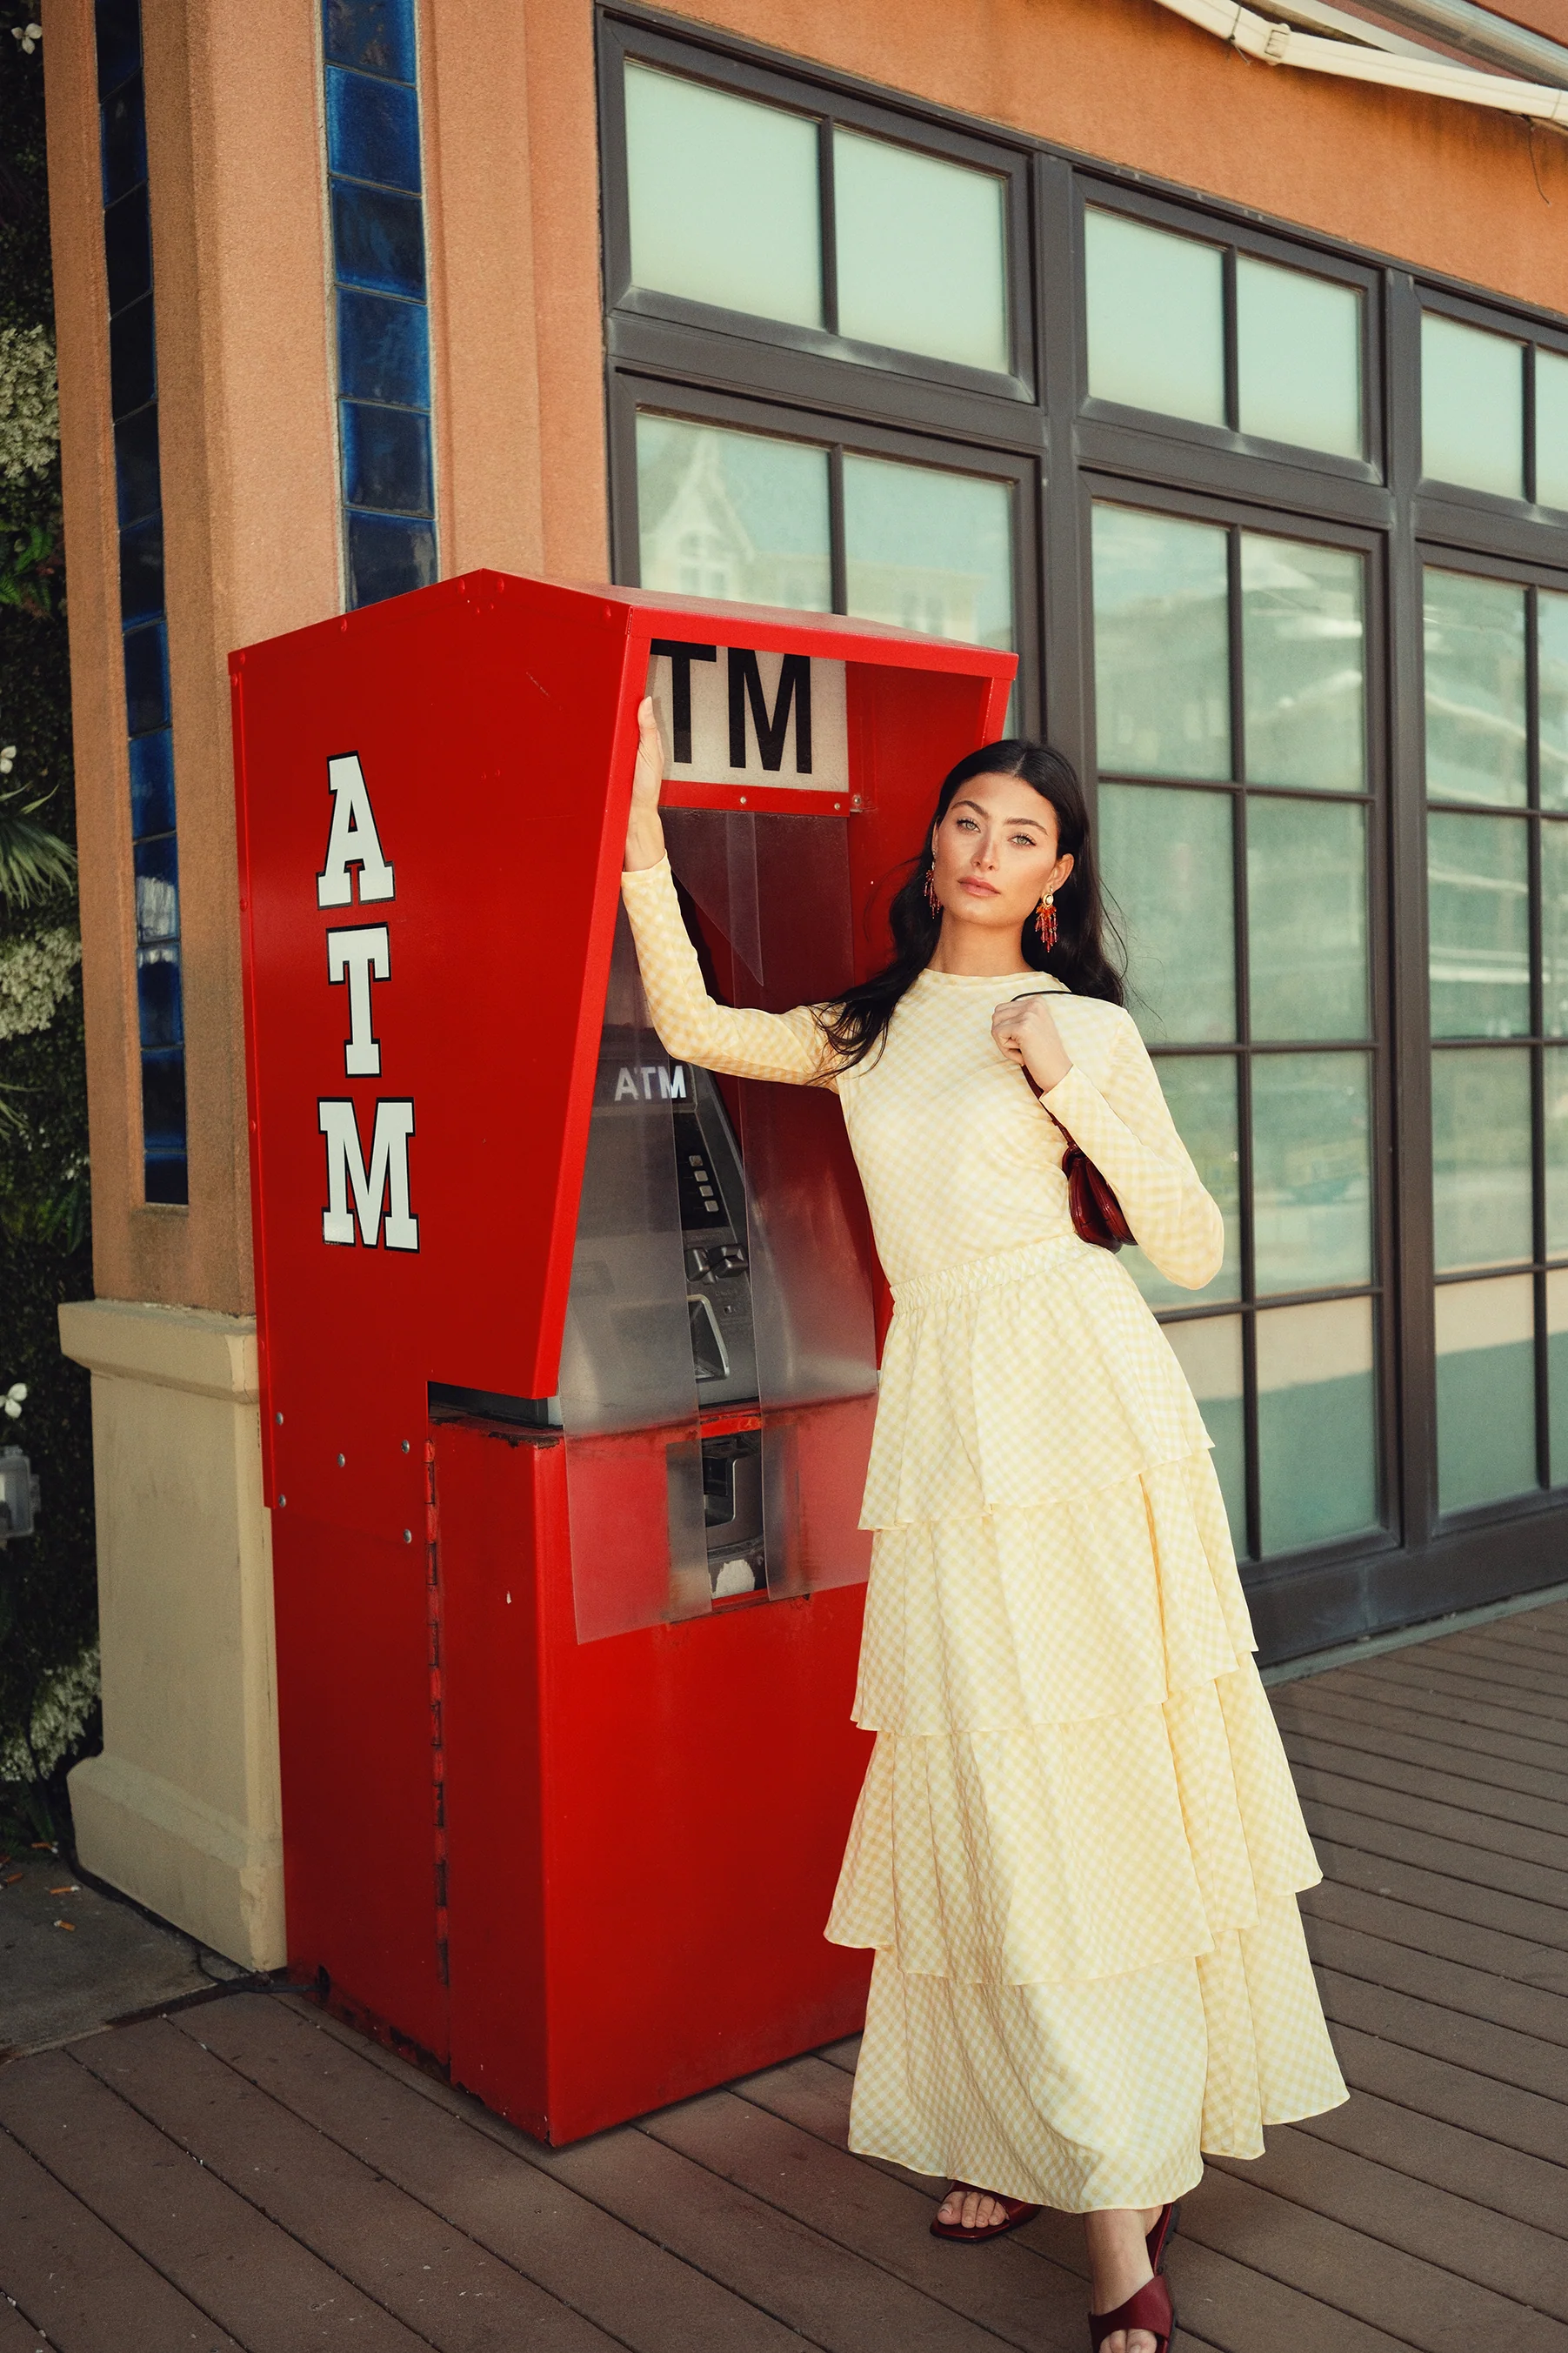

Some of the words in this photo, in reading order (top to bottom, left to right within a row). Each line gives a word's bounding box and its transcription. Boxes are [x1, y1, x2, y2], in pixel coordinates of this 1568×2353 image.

[650, 638, 812, 774] TM
[317, 751, 420, 1253] ATM
[614, 1066, 687, 1101] ATM
